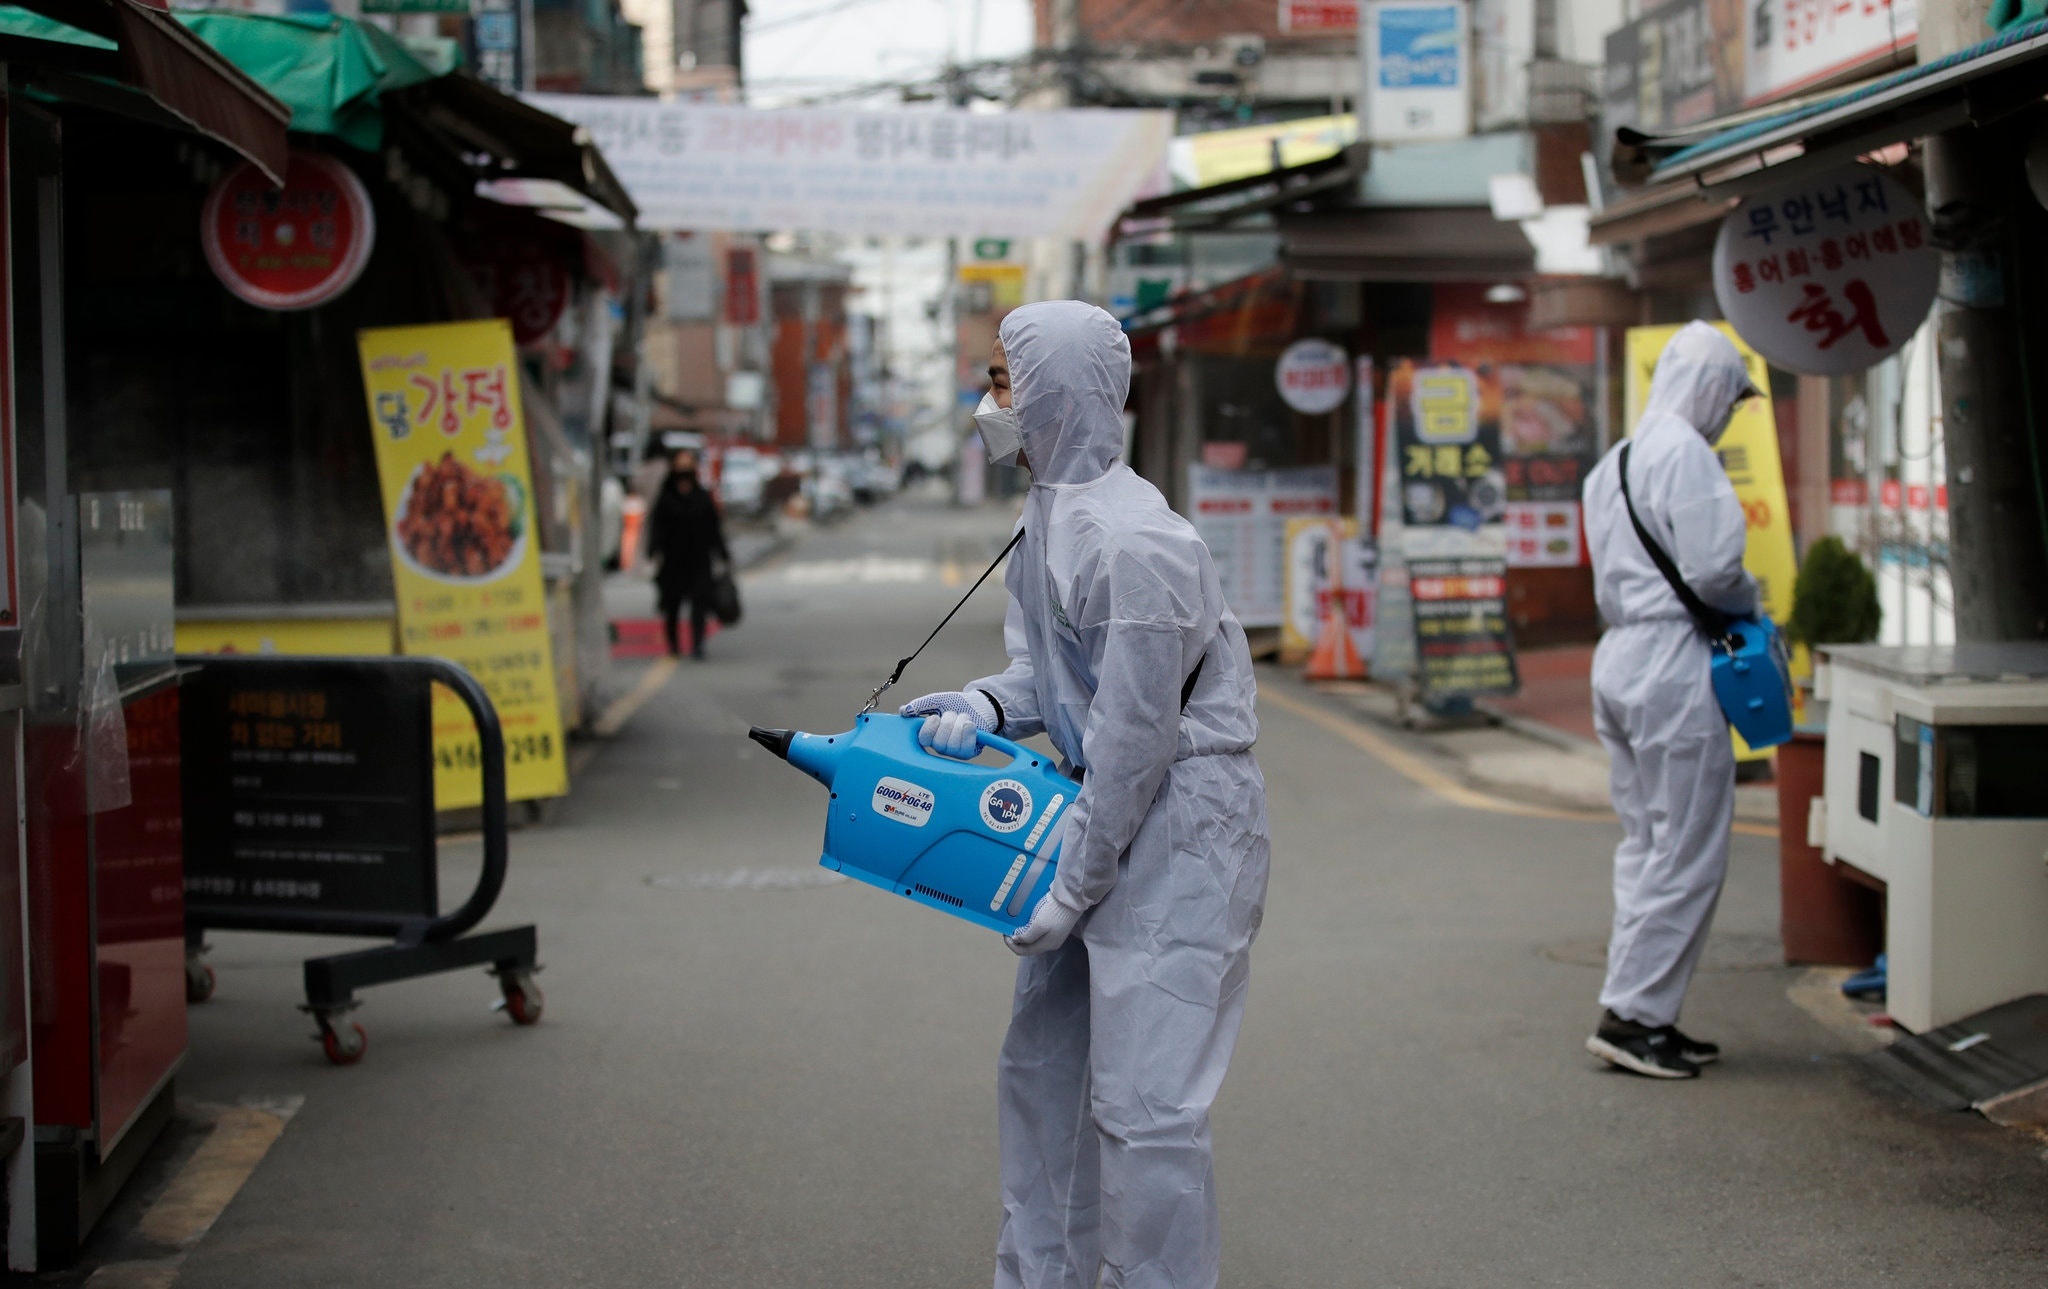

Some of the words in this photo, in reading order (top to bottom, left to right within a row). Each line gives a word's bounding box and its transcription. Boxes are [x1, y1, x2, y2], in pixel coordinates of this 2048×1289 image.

[1744, 177, 1889, 244] 무안낙지
[1786, 278, 1892, 349] 회
[1404, 443, 1493, 478] 거래소
[301, 721, 342, 749] 거리
[876, 785, 903, 801] GOOD
[918, 791, 931, 799] LTE
[989, 797, 1018, 813] GAON
[1001, 809, 1021, 822] IPM
